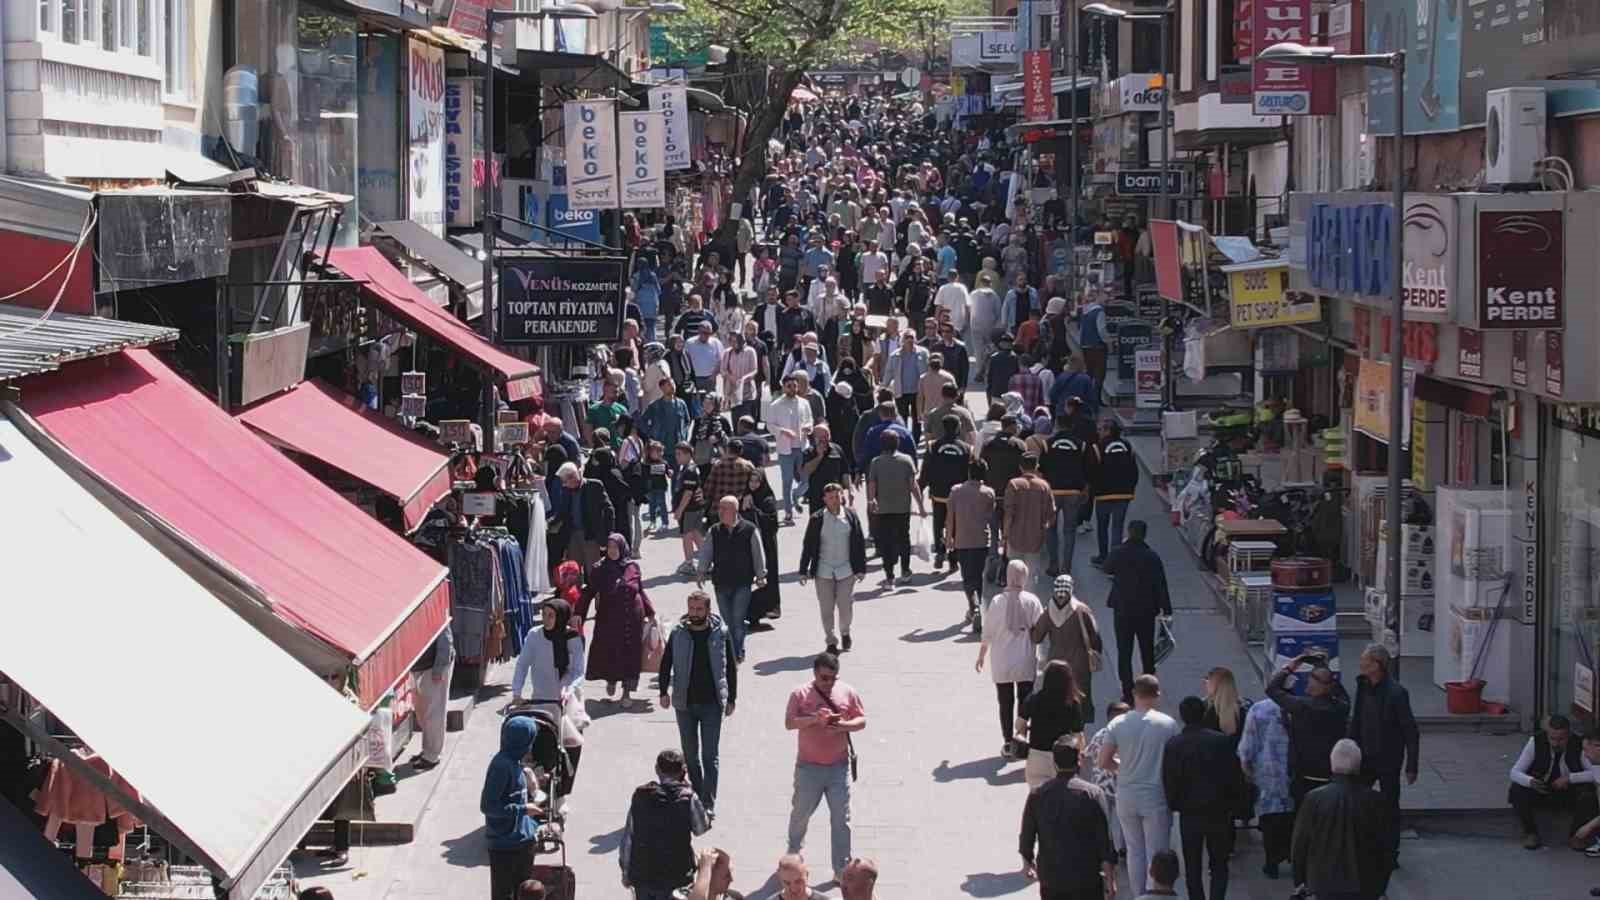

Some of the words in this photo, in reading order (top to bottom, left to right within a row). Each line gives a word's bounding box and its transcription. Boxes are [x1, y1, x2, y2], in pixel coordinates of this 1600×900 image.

[581, 106, 598, 176] beko
[634, 119, 648, 179] beko
[1125, 173, 1174, 187] bami
[554, 208, 594, 221] beko
[1403, 261, 1446, 288] Kent
[1403, 288, 1446, 308] PERDE
[1487, 286, 1556, 305] Kent
[508, 301, 556, 316] TOPTAN
[559, 298, 614, 316] FİYATINA
[1487, 306, 1556, 321] PERDE
[524, 320, 598, 335] PERAKENDE
[1525, 481, 1535, 538] KENT
[1525, 547, 1535, 617] PERDE
